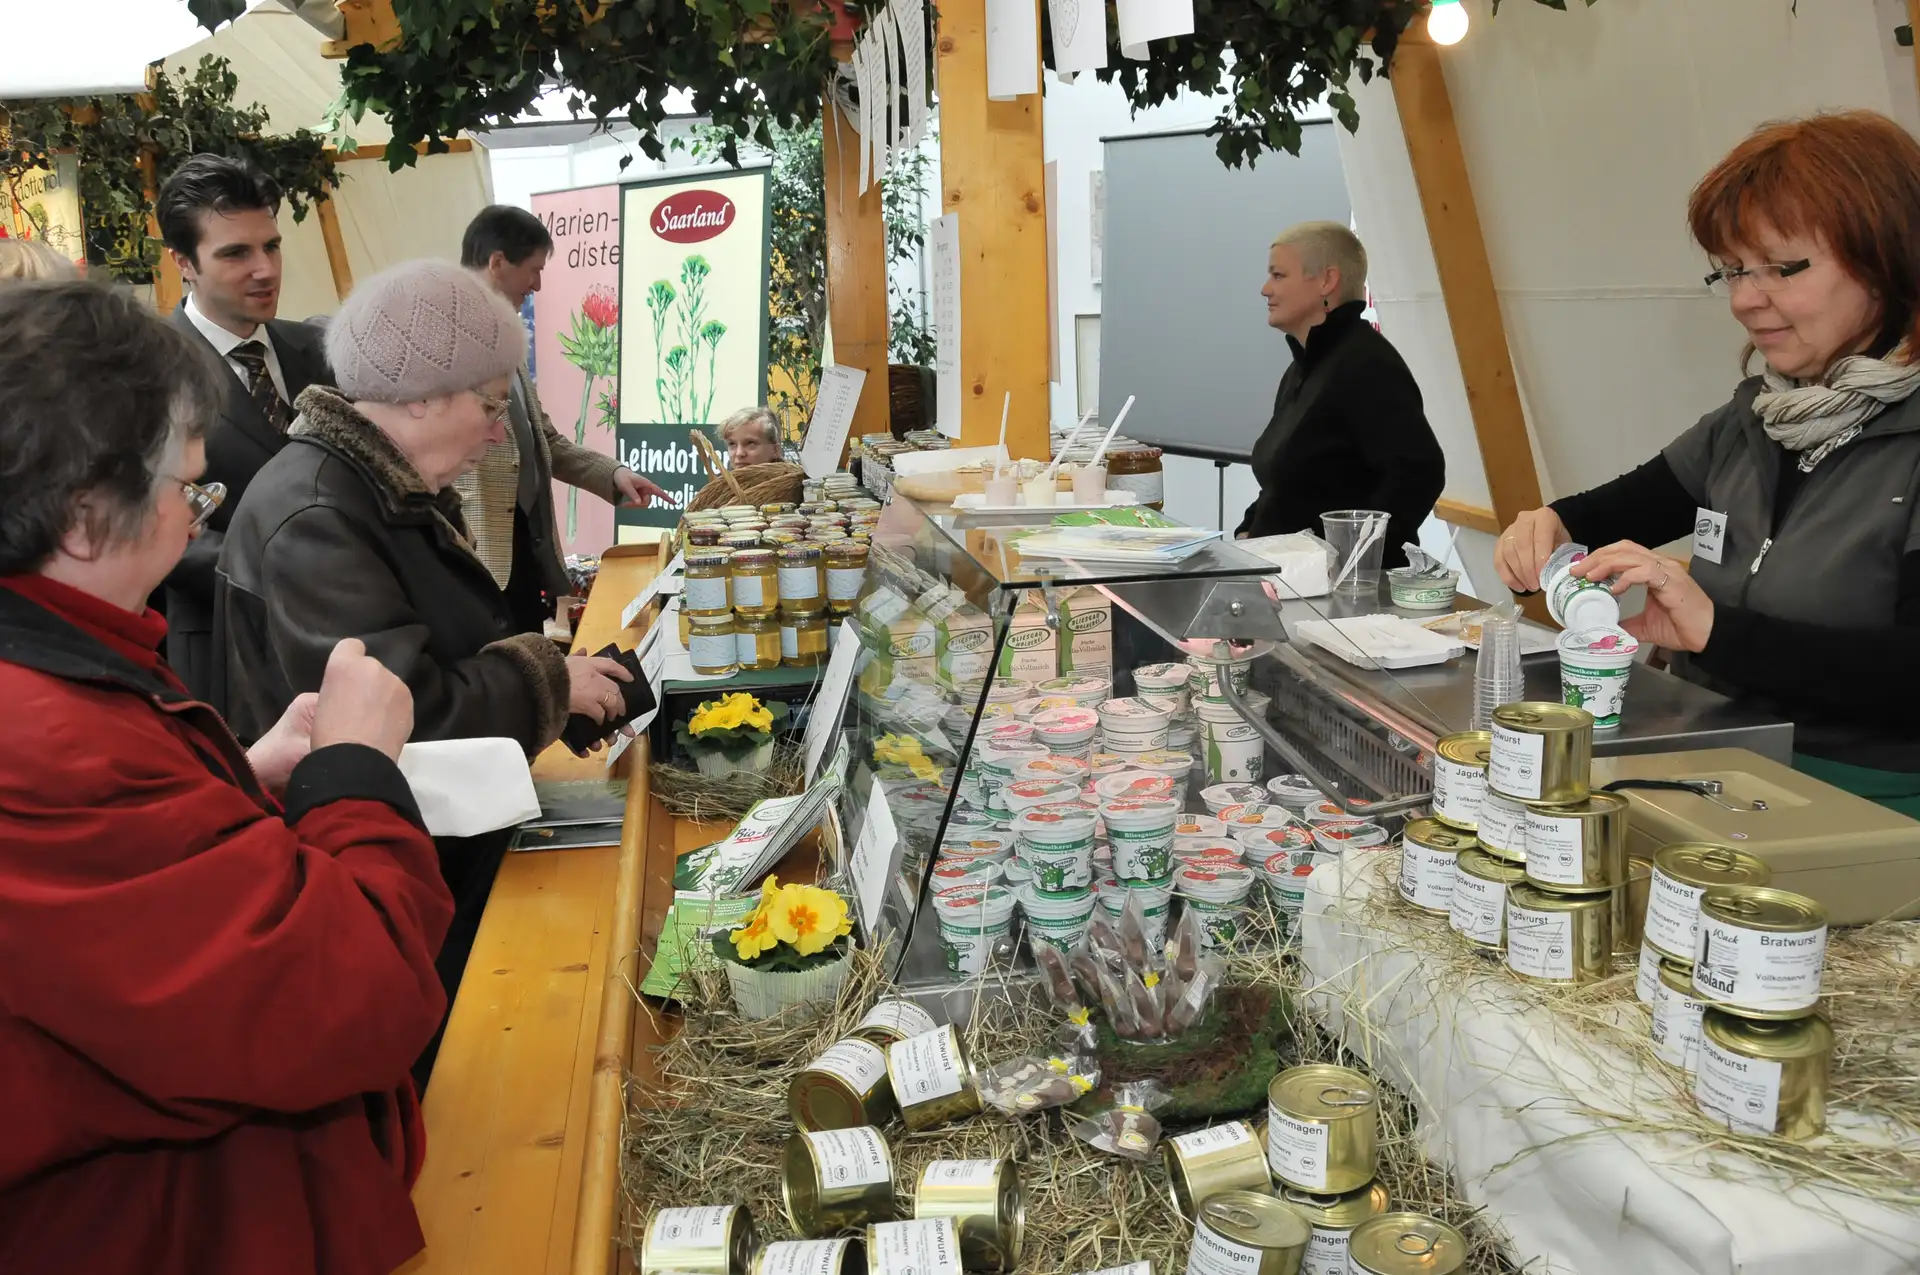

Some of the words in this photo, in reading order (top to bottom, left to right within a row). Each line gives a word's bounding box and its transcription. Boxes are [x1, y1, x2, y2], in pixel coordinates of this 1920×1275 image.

[538, 208, 619, 237] Marien-
[656, 201, 731, 234] Saarland
[1653, 871, 1695, 899] Bratwurst
[1760, 935, 1817, 947] Bratwurst
[1696, 962, 1736, 994] Bioland
[1755, 973, 1806, 982] Vollkonserve
[938, 1031, 953, 1071] Blutwurst
[1310, 1234, 1349, 1246] magen
